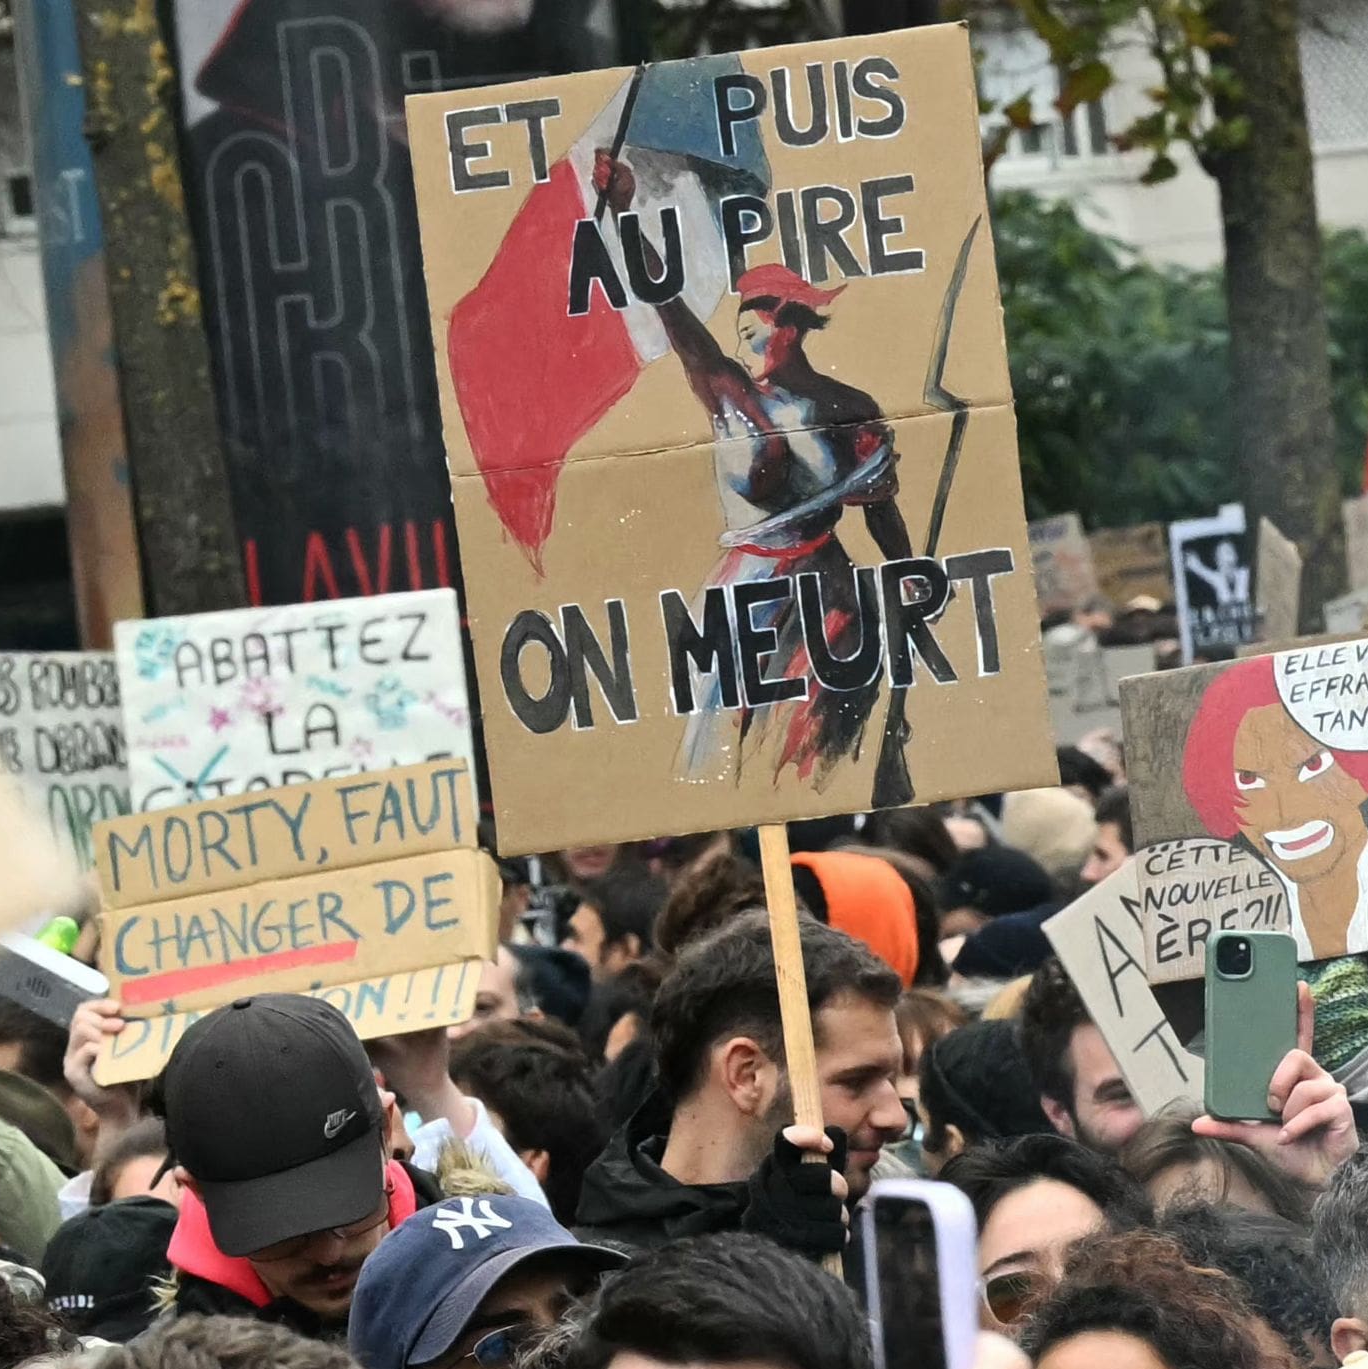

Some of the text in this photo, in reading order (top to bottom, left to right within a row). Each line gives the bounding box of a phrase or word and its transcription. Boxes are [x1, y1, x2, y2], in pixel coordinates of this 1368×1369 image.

[444, 56, 907, 195] ET PUIS
[567, 174, 927, 317] AU PIRE
[173, 612, 432, 689] ABATTEZ
[500, 548, 1015, 736] ON MEURT
[1284, 643, 1348, 676] ELLE
[263, 702, 341, 757] LA
[107, 791, 330, 892] MORTY,
[337, 768, 469, 846] FAUT
[1145, 843, 1248, 876] CETTE
[113, 871, 460, 978] CHANGER DE
[1144, 869, 1276, 913] NOUVELLE
[431, 1196, 513, 1251] NY
